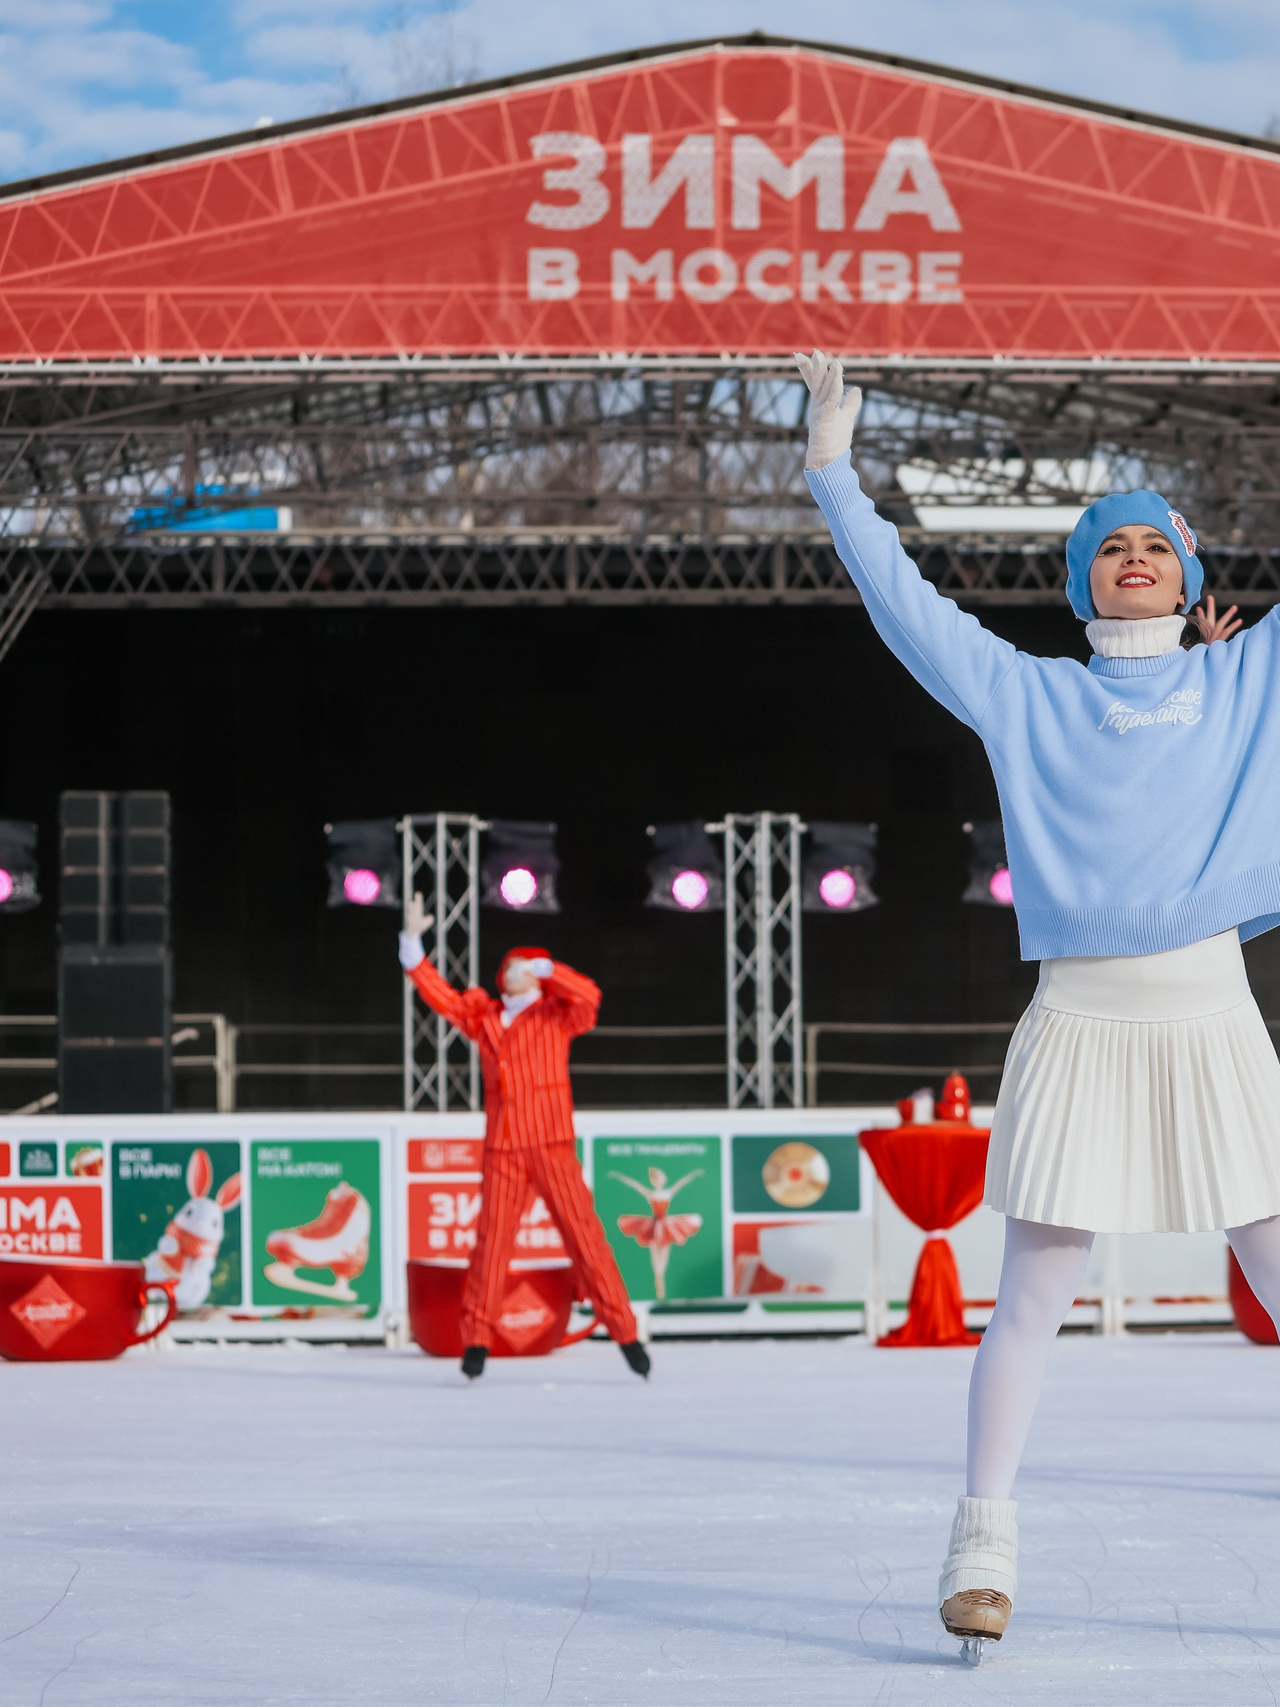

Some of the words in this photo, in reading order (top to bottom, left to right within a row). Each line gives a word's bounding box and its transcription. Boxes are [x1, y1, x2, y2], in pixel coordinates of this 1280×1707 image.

[525, 130, 963, 232] ЗИМА
[526, 247, 581, 301] В
[610, 247, 964, 304] МОСКВЕ
[0, 1196, 82, 1231] МА
[428, 1192, 552, 1226] ЗИА
[428, 1228, 448, 1249] В
